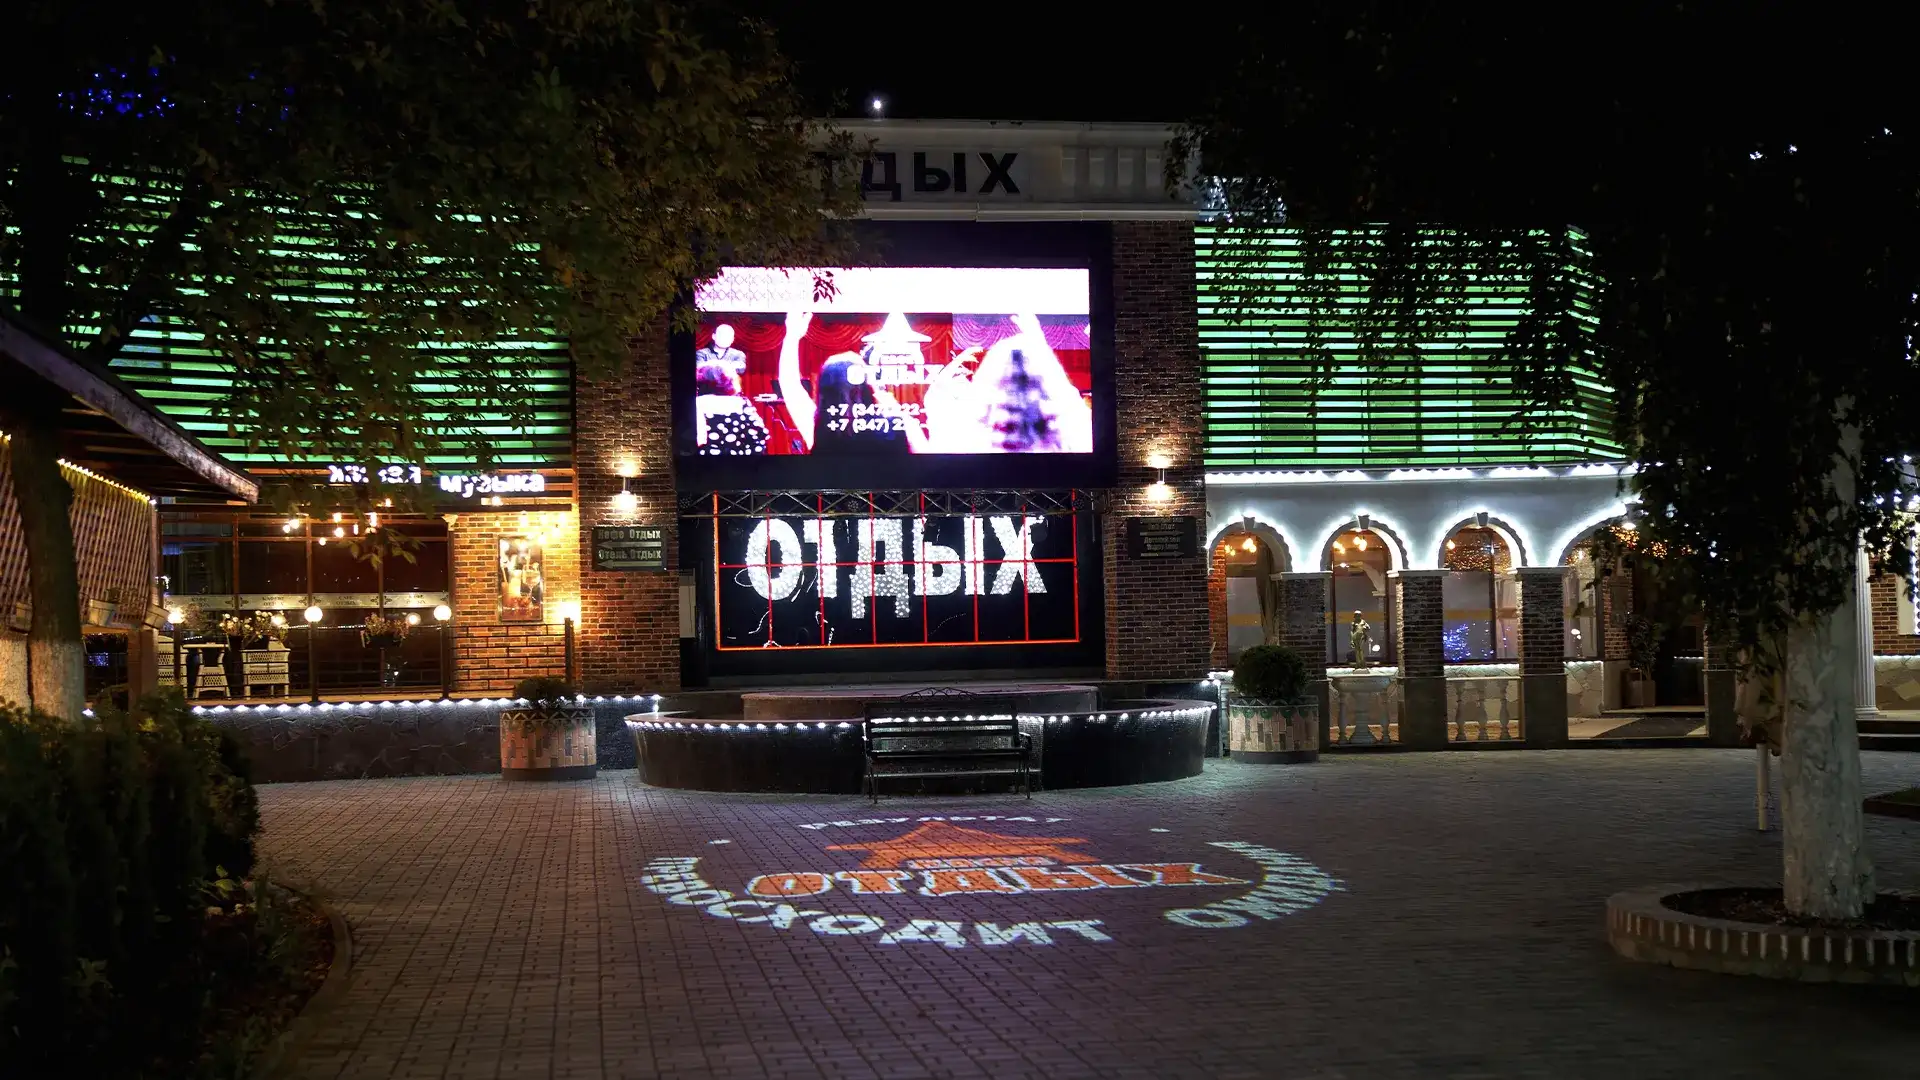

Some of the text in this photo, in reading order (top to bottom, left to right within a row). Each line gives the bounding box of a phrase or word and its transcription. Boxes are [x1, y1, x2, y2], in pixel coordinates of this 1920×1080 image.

[808, 151, 1020, 201] ТДЫХ
[852, 403, 889, 418] (347
[440, 474, 544, 498] музыка
[629, 529, 661, 539] Отдых
[599, 549, 661, 560] Отель Отдых
[746, 515, 1048, 619] ОТДЫХ
[744, 861, 1255, 898] ОТДЫХ
[639, 856, 1114, 947] ПРЕВОСХОДИТ
